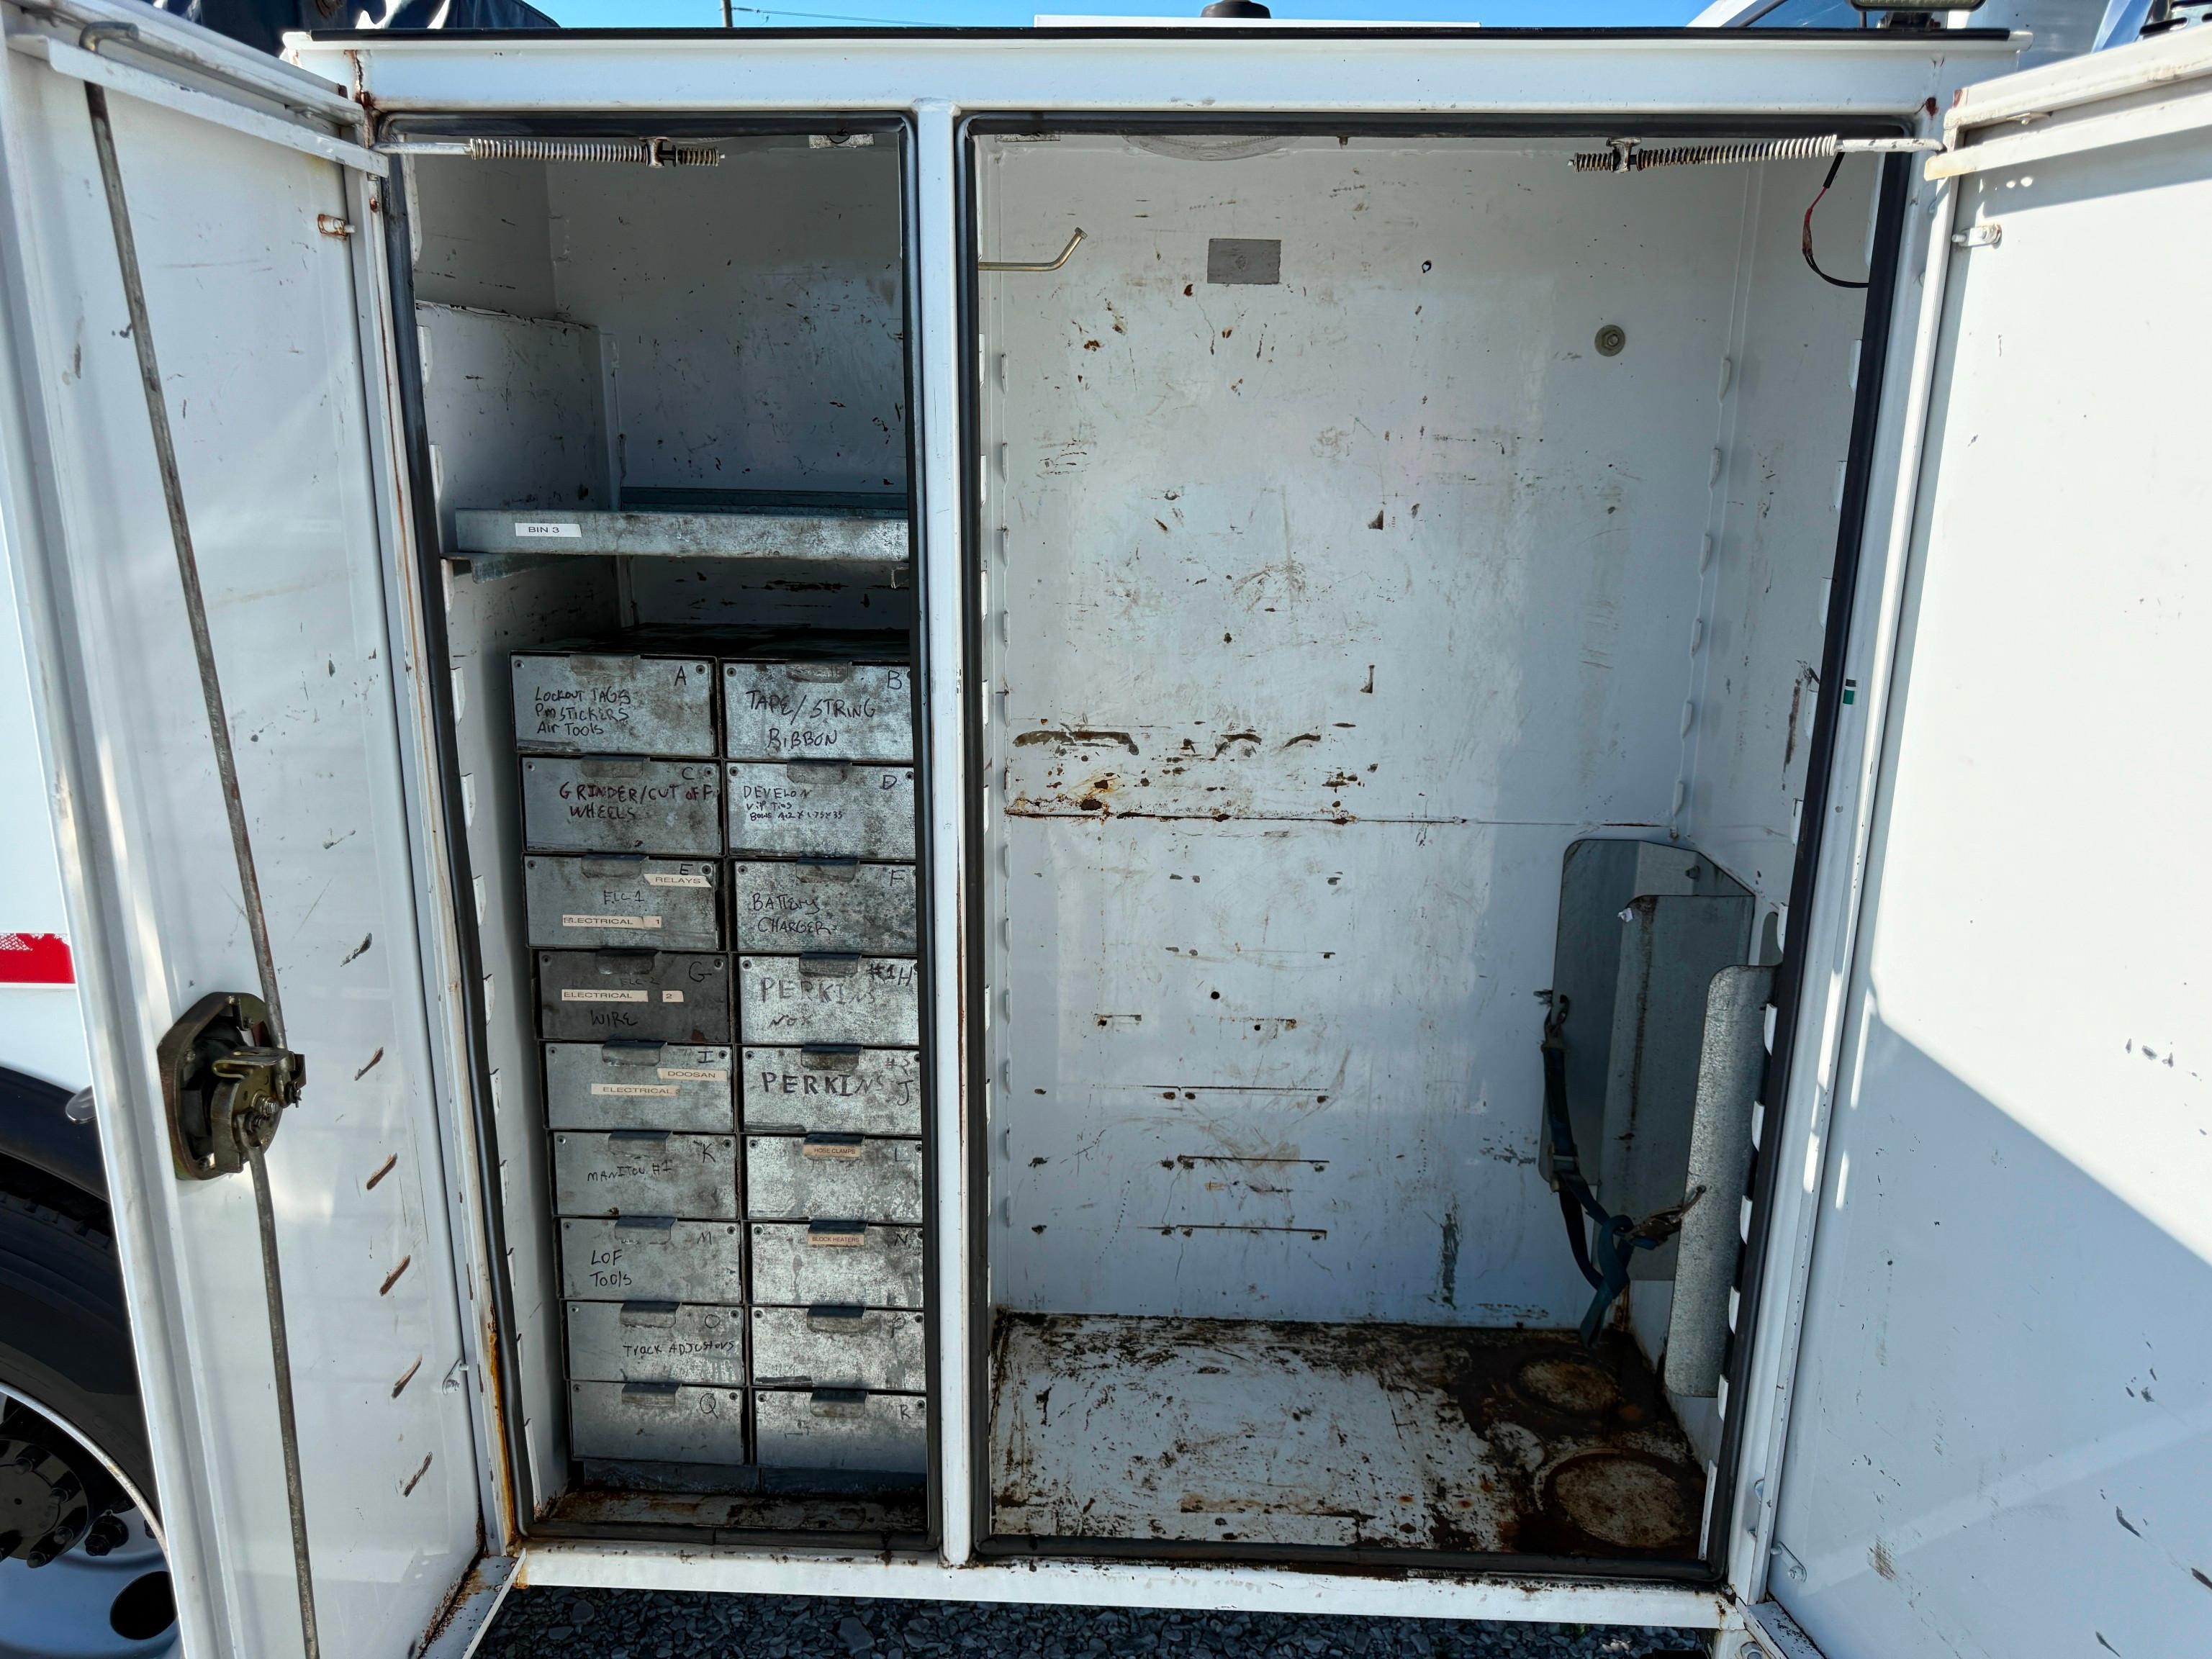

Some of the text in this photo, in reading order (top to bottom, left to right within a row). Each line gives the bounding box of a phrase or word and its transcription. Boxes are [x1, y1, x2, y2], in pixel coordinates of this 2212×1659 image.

[674, 665, 687, 686] A
[887, 670, 903, 690] B
[592, 686, 631, 706] TAGS
[537, 720, 559, 734] Air
[767, 728, 838, 749] RIBBON
[682, 767, 695, 780] C
[882, 774, 898, 790] D
[744, 785, 811, 800] DEVELON
[570, 803, 636, 820] WHEELS
[680, 863, 693, 876] E
[889, 869, 906, 887] F
[564, 917, 633, 926] ELECTRICAL
[757, 916, 832, 935] CHARGER
[688, 961, 713, 982] G
[898, 966, 913, 987] H
[590, 1009, 638, 1029] WIRE
[698, 1050, 715, 1064] I
[761, 1072, 884, 1097] PERKINS
[896, 1080, 914, 1106] J
[702, 1142, 716, 1163] K
[894, 1147, 911, 1162] L
[697, 1231, 712, 1245] M
[893, 1233, 909, 1247] N
[590, 1249, 623, 1266] LOF
[590, 1270, 633, 1288] Tools
[704, 1314, 720, 1329] O
[700, 1392, 719, 1419] Q
[899, 1404, 911, 1420] R
